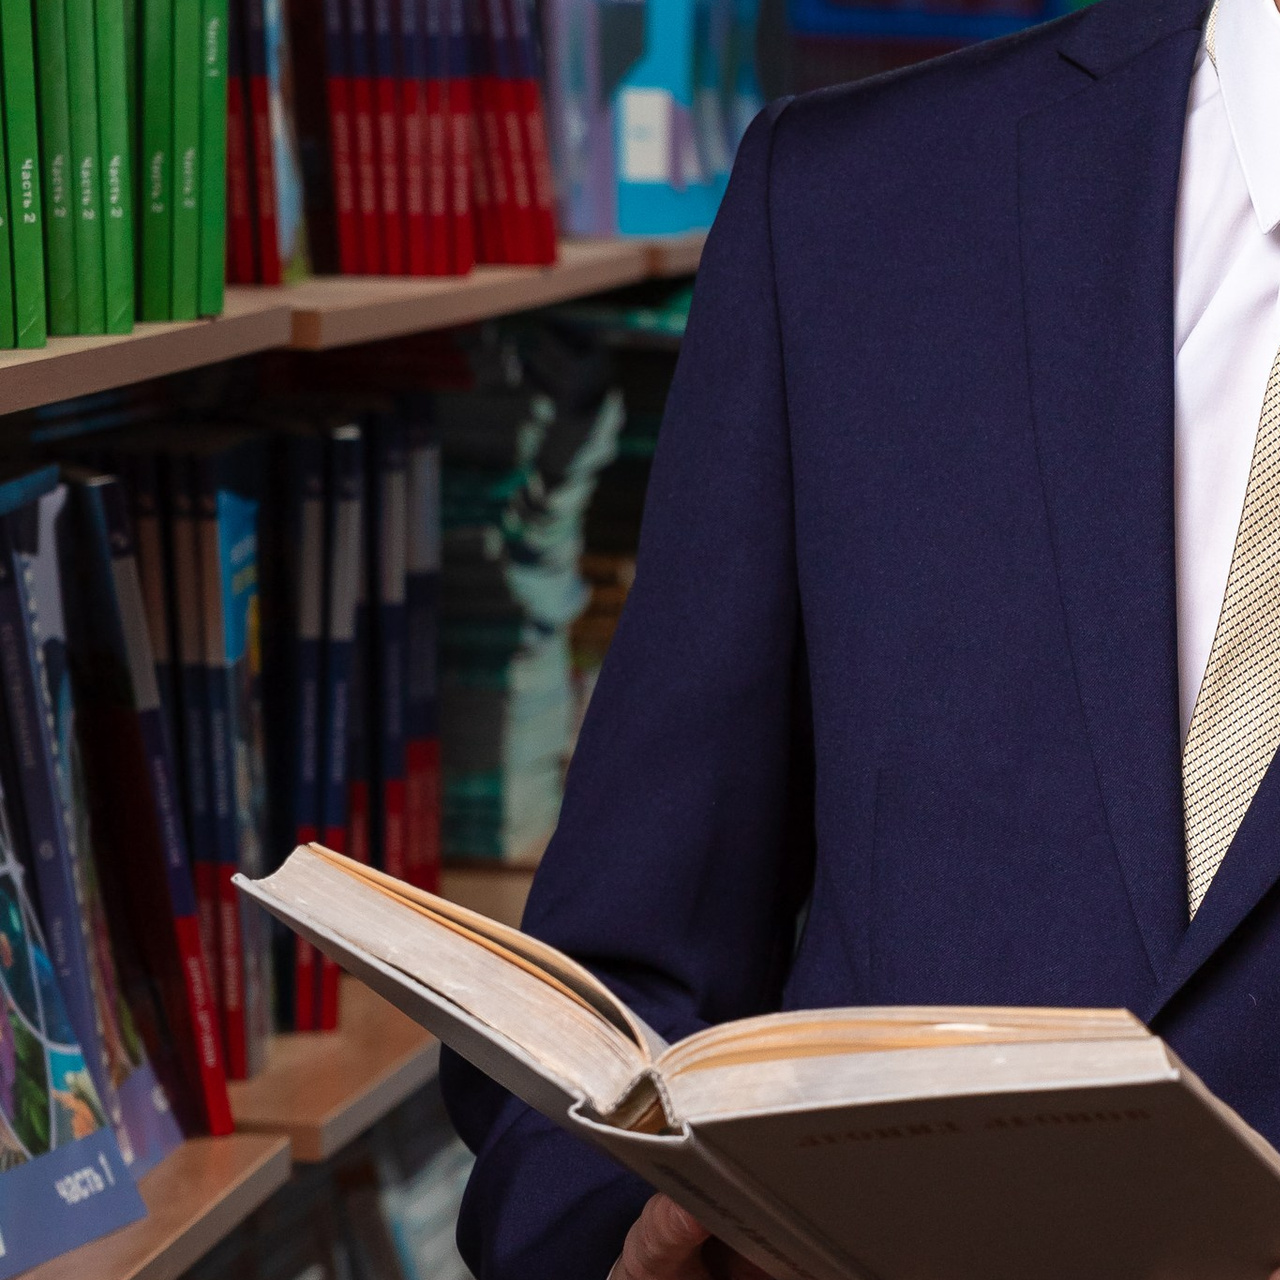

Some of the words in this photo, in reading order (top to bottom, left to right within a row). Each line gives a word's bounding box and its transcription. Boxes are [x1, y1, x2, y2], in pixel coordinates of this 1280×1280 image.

[21, 158, 33, 209] Часть
[81, 156, 92, 206] Часть
[110, 155, 120, 205] Часть
[24, 213, 36, 223] 2
